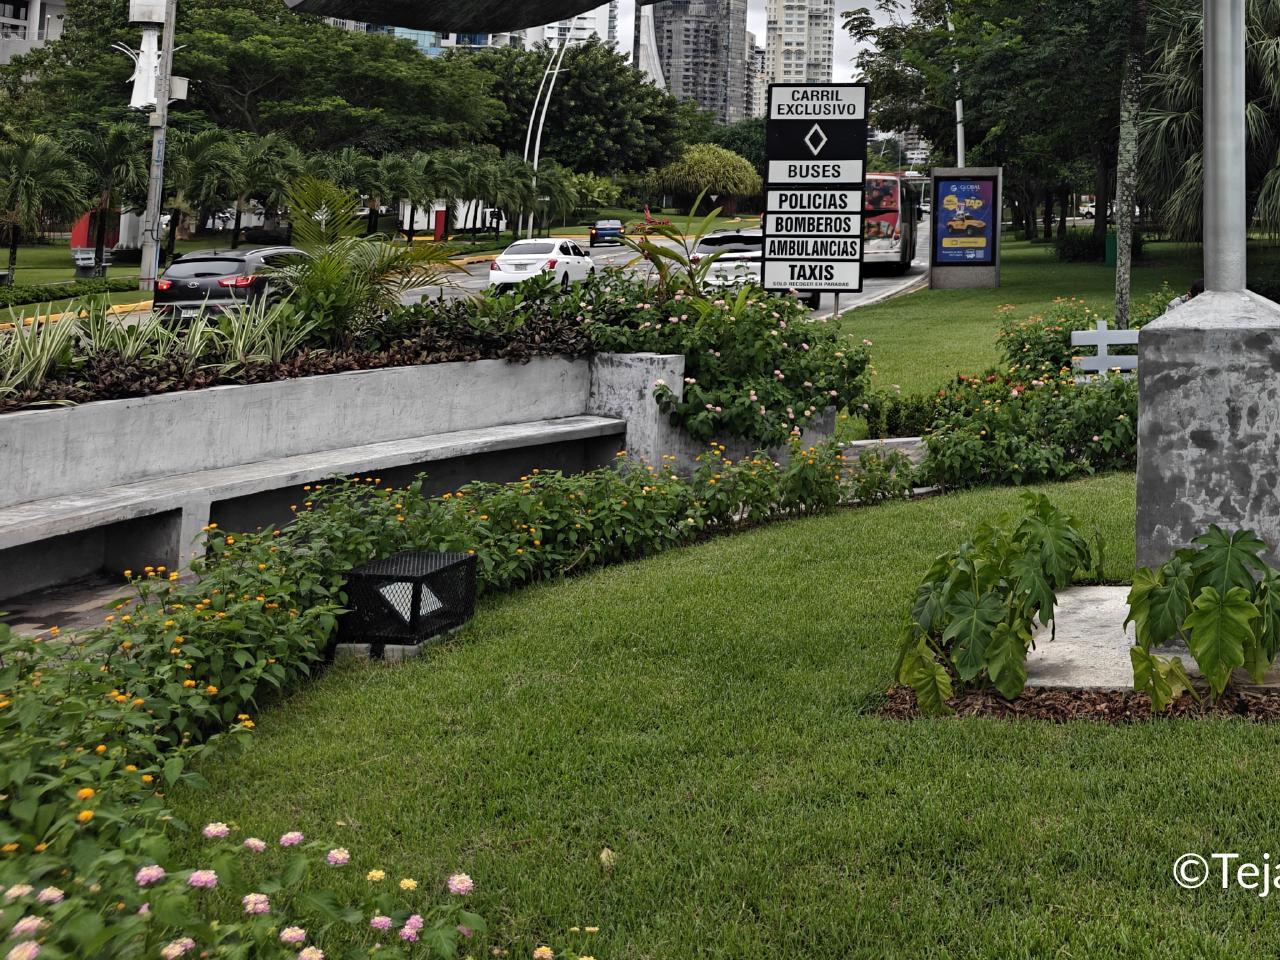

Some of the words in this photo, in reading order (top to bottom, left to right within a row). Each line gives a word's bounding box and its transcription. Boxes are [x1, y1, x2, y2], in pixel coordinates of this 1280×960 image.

[791, 89, 843, 102] CARRIL
[777, 103, 856, 116] EXCLUSIVO
[788, 164, 841, 179] BUSES
[778, 193, 848, 210] POLICIAS
[775, 216, 851, 233] BOMBEROS
[768, 240, 857, 257] AMBULANCIAS
[788, 264, 834, 281] TAXIS
